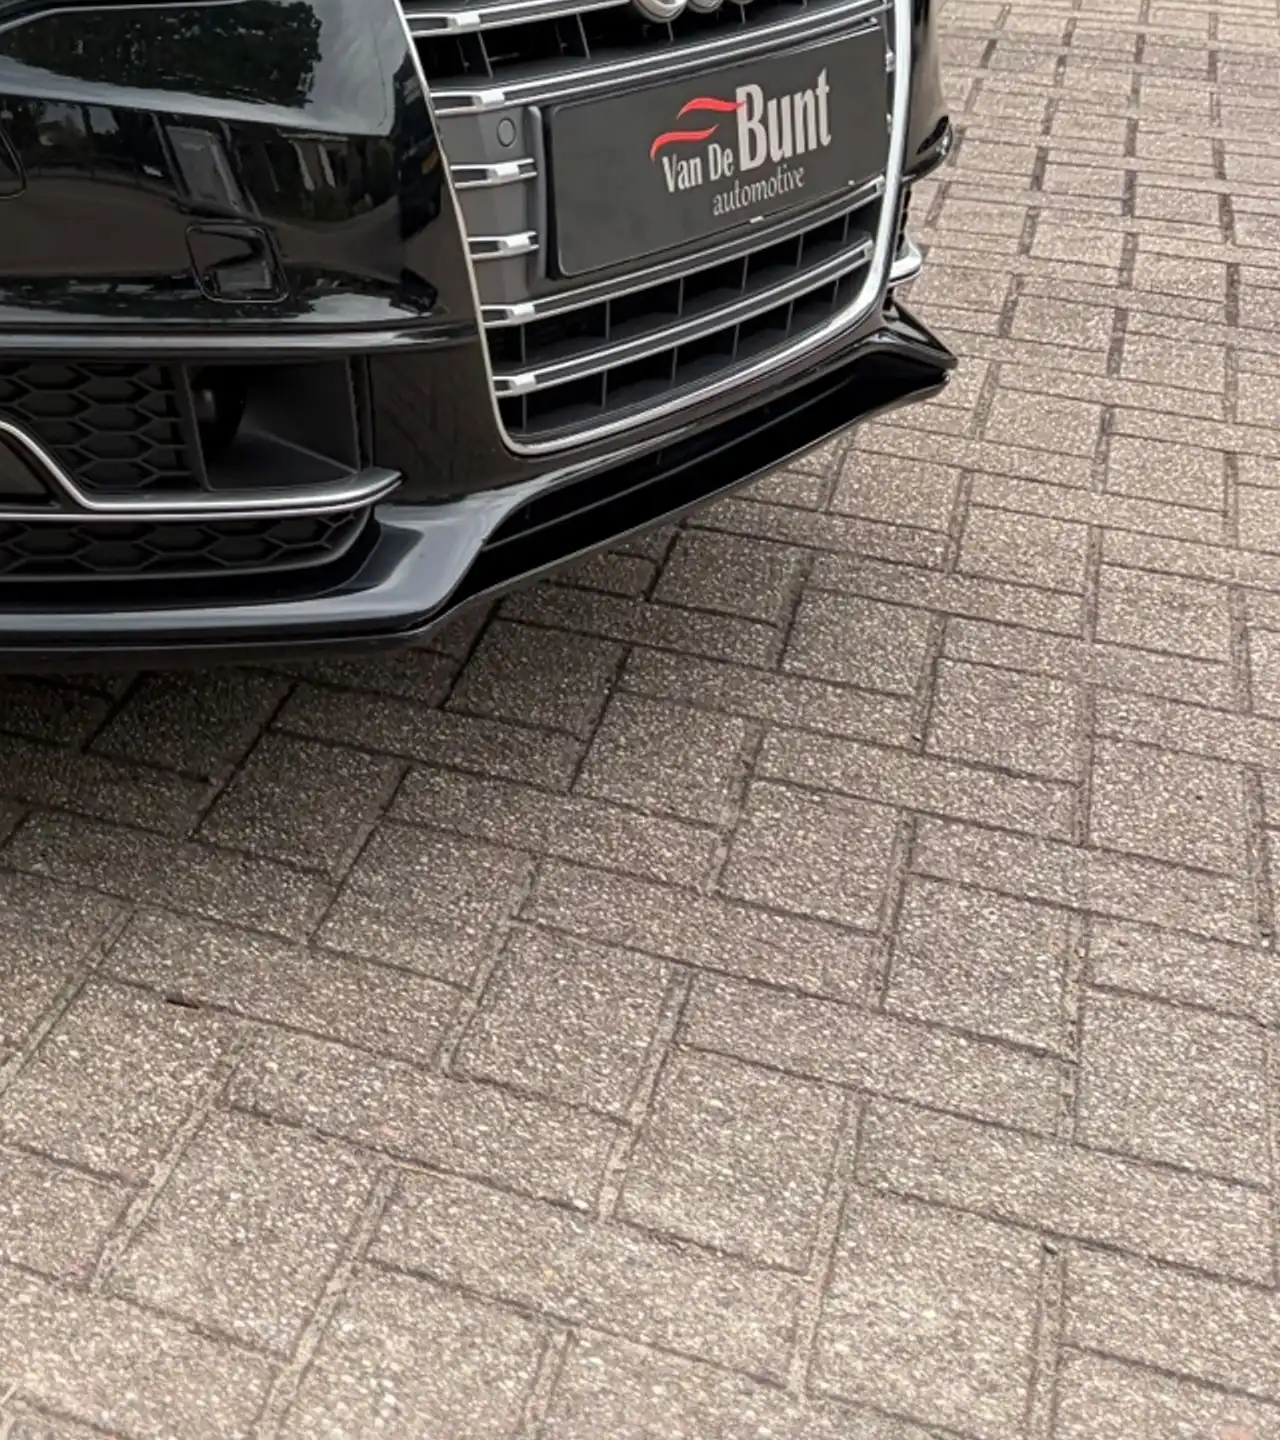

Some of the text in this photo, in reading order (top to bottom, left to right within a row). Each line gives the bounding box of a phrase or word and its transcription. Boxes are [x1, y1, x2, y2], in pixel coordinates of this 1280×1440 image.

[661, 66, 832, 193] Van De Bunt
[712, 162, 806, 216] automotive
